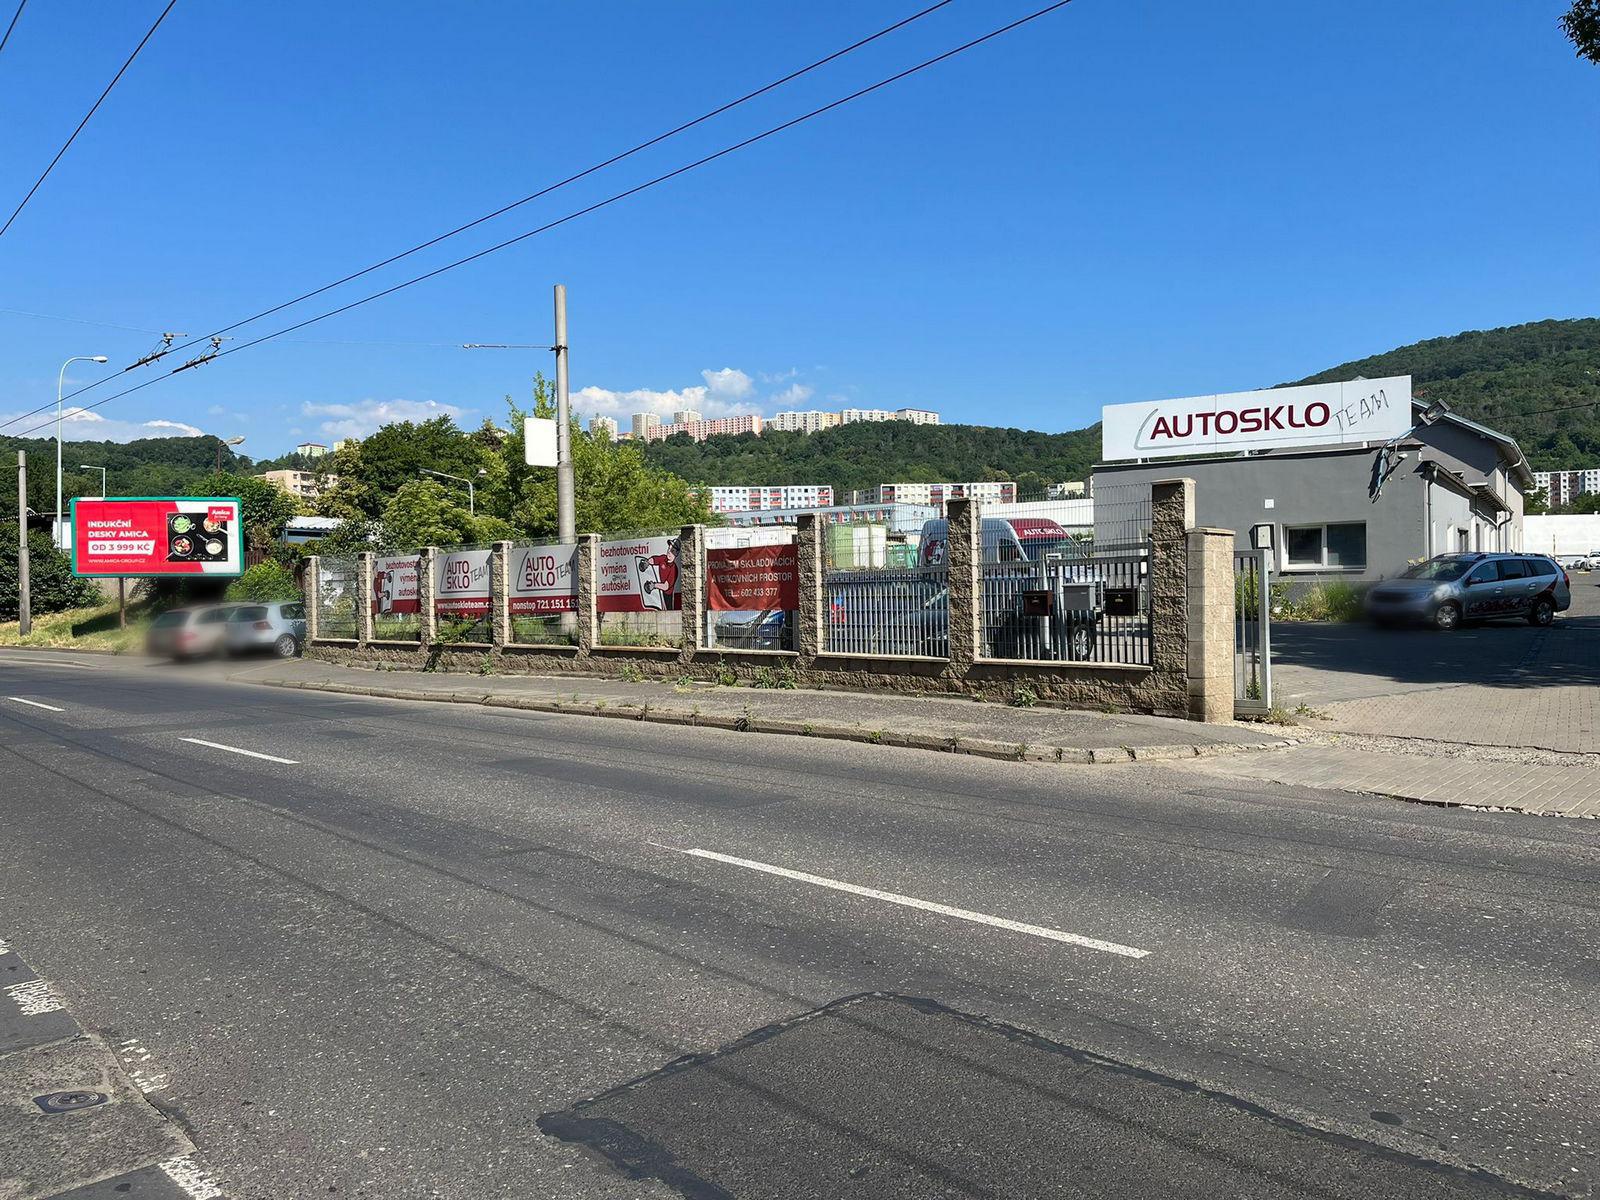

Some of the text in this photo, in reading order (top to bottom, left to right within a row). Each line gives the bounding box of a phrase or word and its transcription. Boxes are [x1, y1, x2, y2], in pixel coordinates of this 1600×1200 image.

[1150, 389, 1390, 440] AUTOSKLO TEAM
[88, 519, 132, 528] INDUKČNÍ
[92, 541, 150, 551] OD 3 999 KČ
[600, 541, 649, 558] bezhotovostní
[446, 560, 470, 575] AUTO
[525, 555, 555, 572] AUTO
[601, 562, 627, 577] výměna
[470, 565, 488, 583] TEAM
[525, 571, 556, 588] SKLO
[759, 572, 793, 581] PROSTOR
[446, 575, 470, 590] SKLO
[601, 579, 631, 592] autoskel
[765, 587, 778, 597] 377
[512, 601, 536, 611] nonstop
[536, 599, 550, 609] 721
[550, 599, 565, 609] 151
